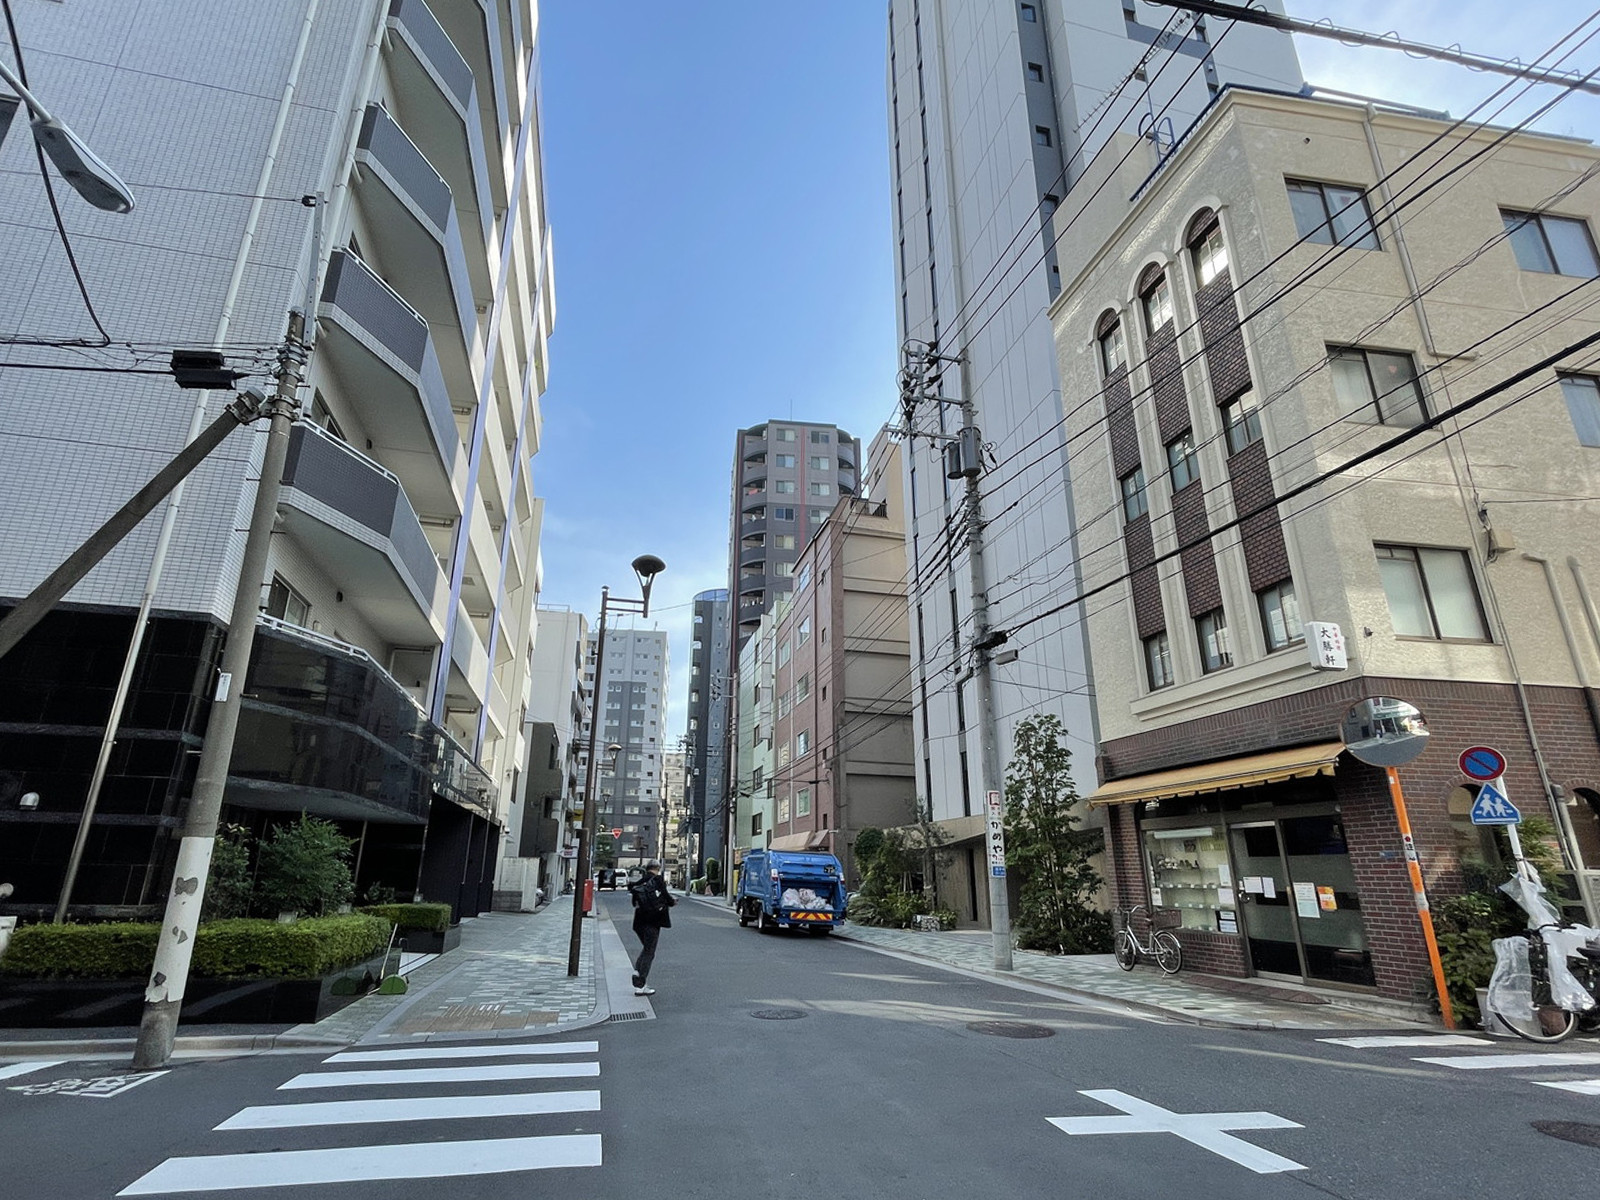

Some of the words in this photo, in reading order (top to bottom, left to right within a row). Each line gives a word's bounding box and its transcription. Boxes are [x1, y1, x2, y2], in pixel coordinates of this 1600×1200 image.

[1320, 627, 1336, 666] 大勝軒
[991, 820, 1003, 854] かめや
